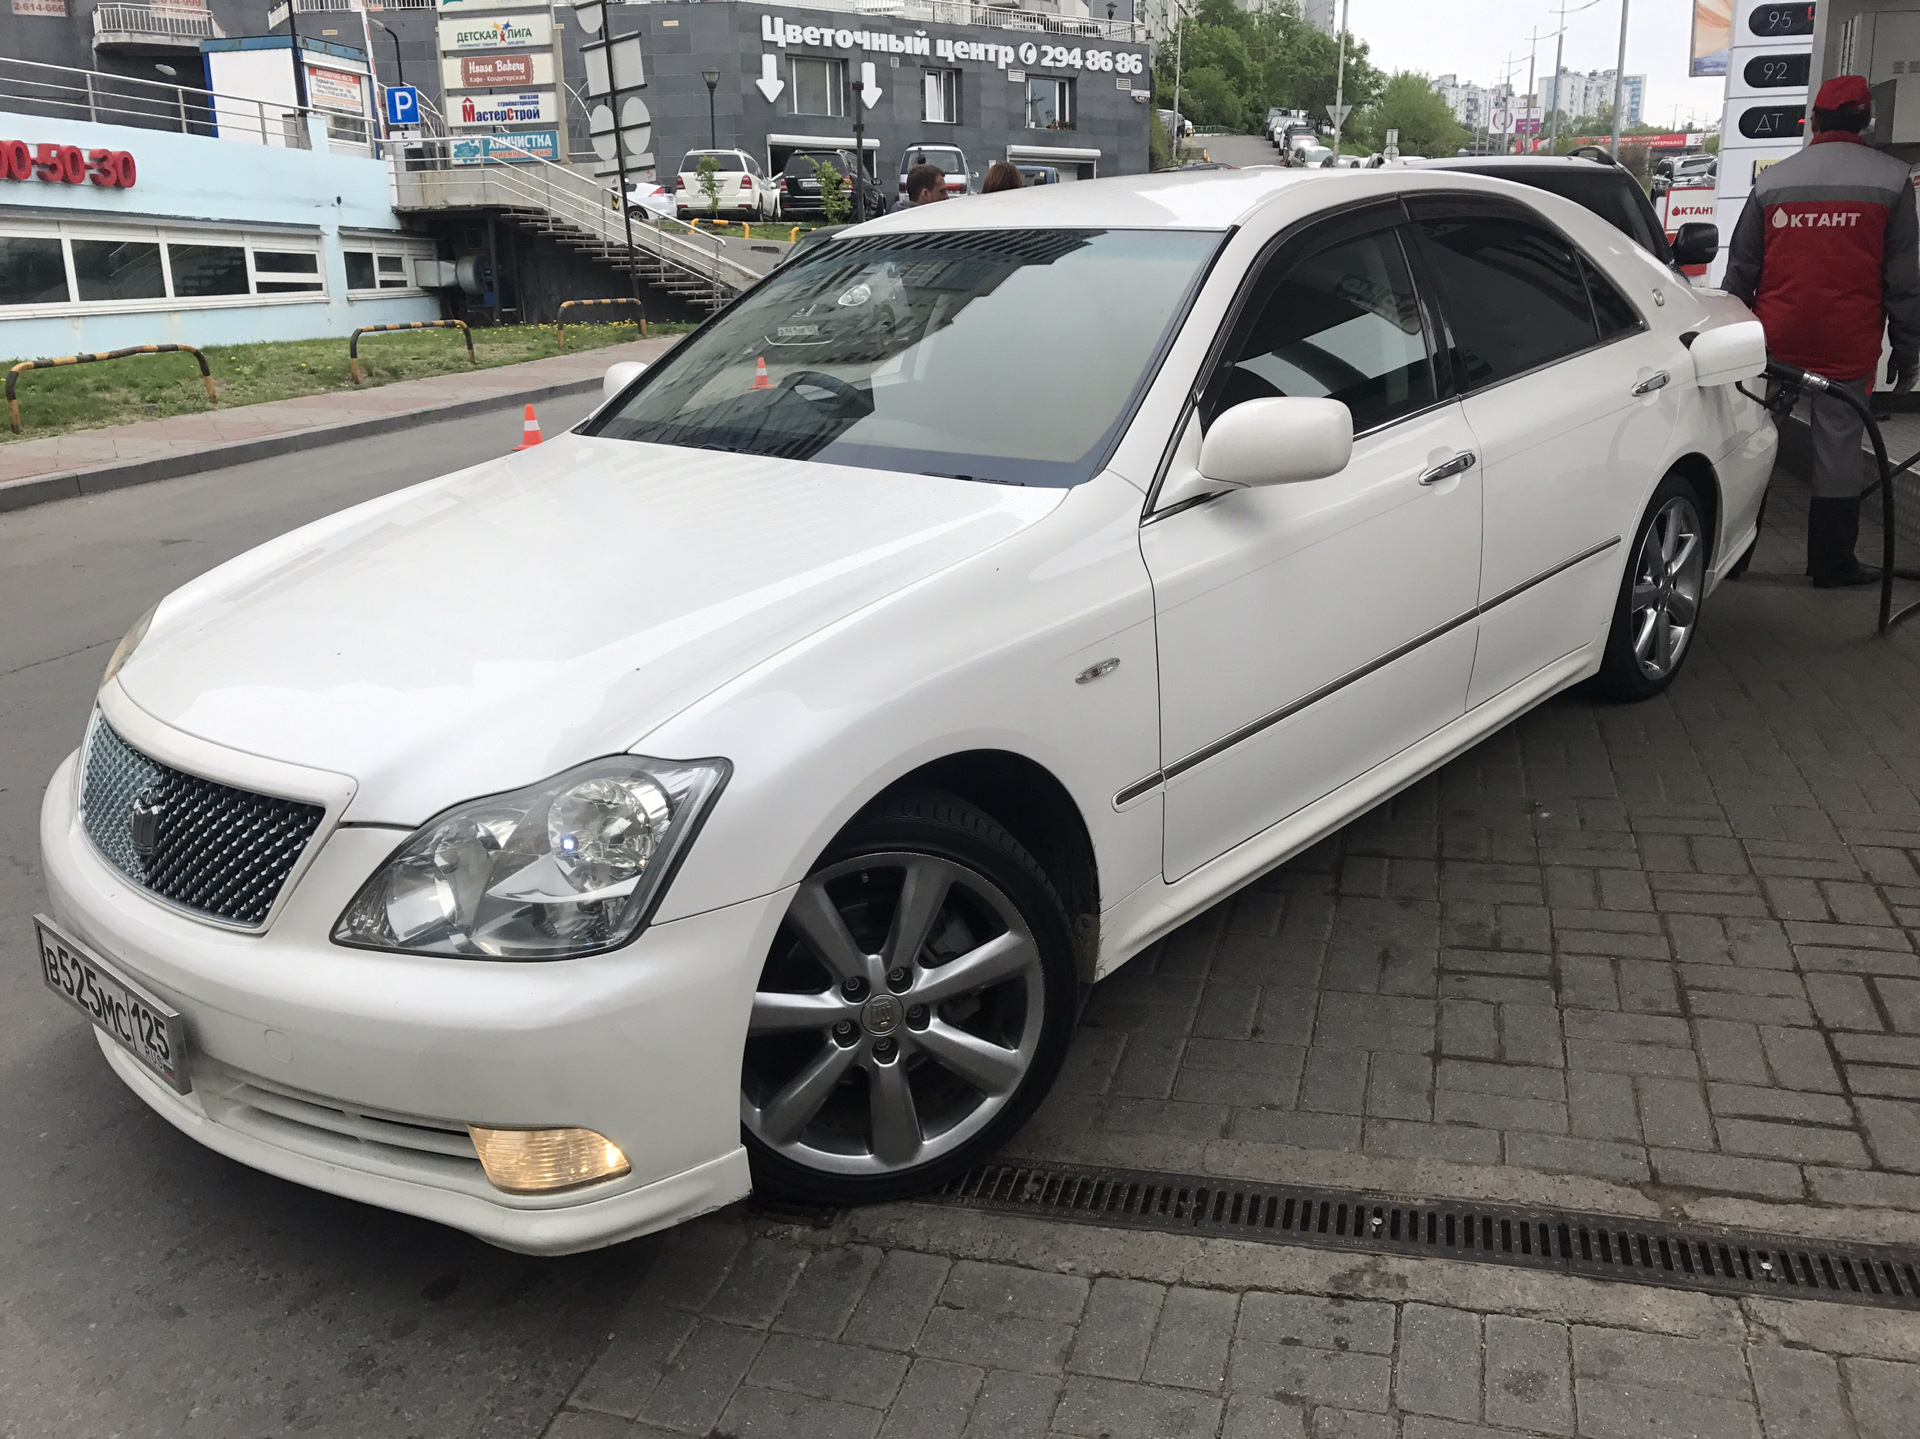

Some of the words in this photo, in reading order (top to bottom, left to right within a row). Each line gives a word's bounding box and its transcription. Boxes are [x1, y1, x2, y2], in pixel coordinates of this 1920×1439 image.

[1769, 11, 1792, 29] 95
[457, 30, 498, 43] ДЕТСКАЯ
[507, 28, 532, 39] ЛИГА
[762, 15, 930, 56] Цветочный
[936, 39, 1015, 69] центр
[1040, 45, 1083, 69] 294
[1085, 49, 1113, 72] 86
[1115, 52, 1143, 74] 86
[469, 61, 493, 74] House
[495, 60, 525, 73] Bakery
[1764, 62, 1787, 80] 92
[394, 91, 412, 120] P
[462, 104, 540, 122] МастерСтрой
[1755, 113, 1784, 133] ДТ
[489, 134, 552, 149] ХИМЧИСТКА
[131, 1002, 170, 1060] 125
[144, 1045, 163, 1069] RUS
